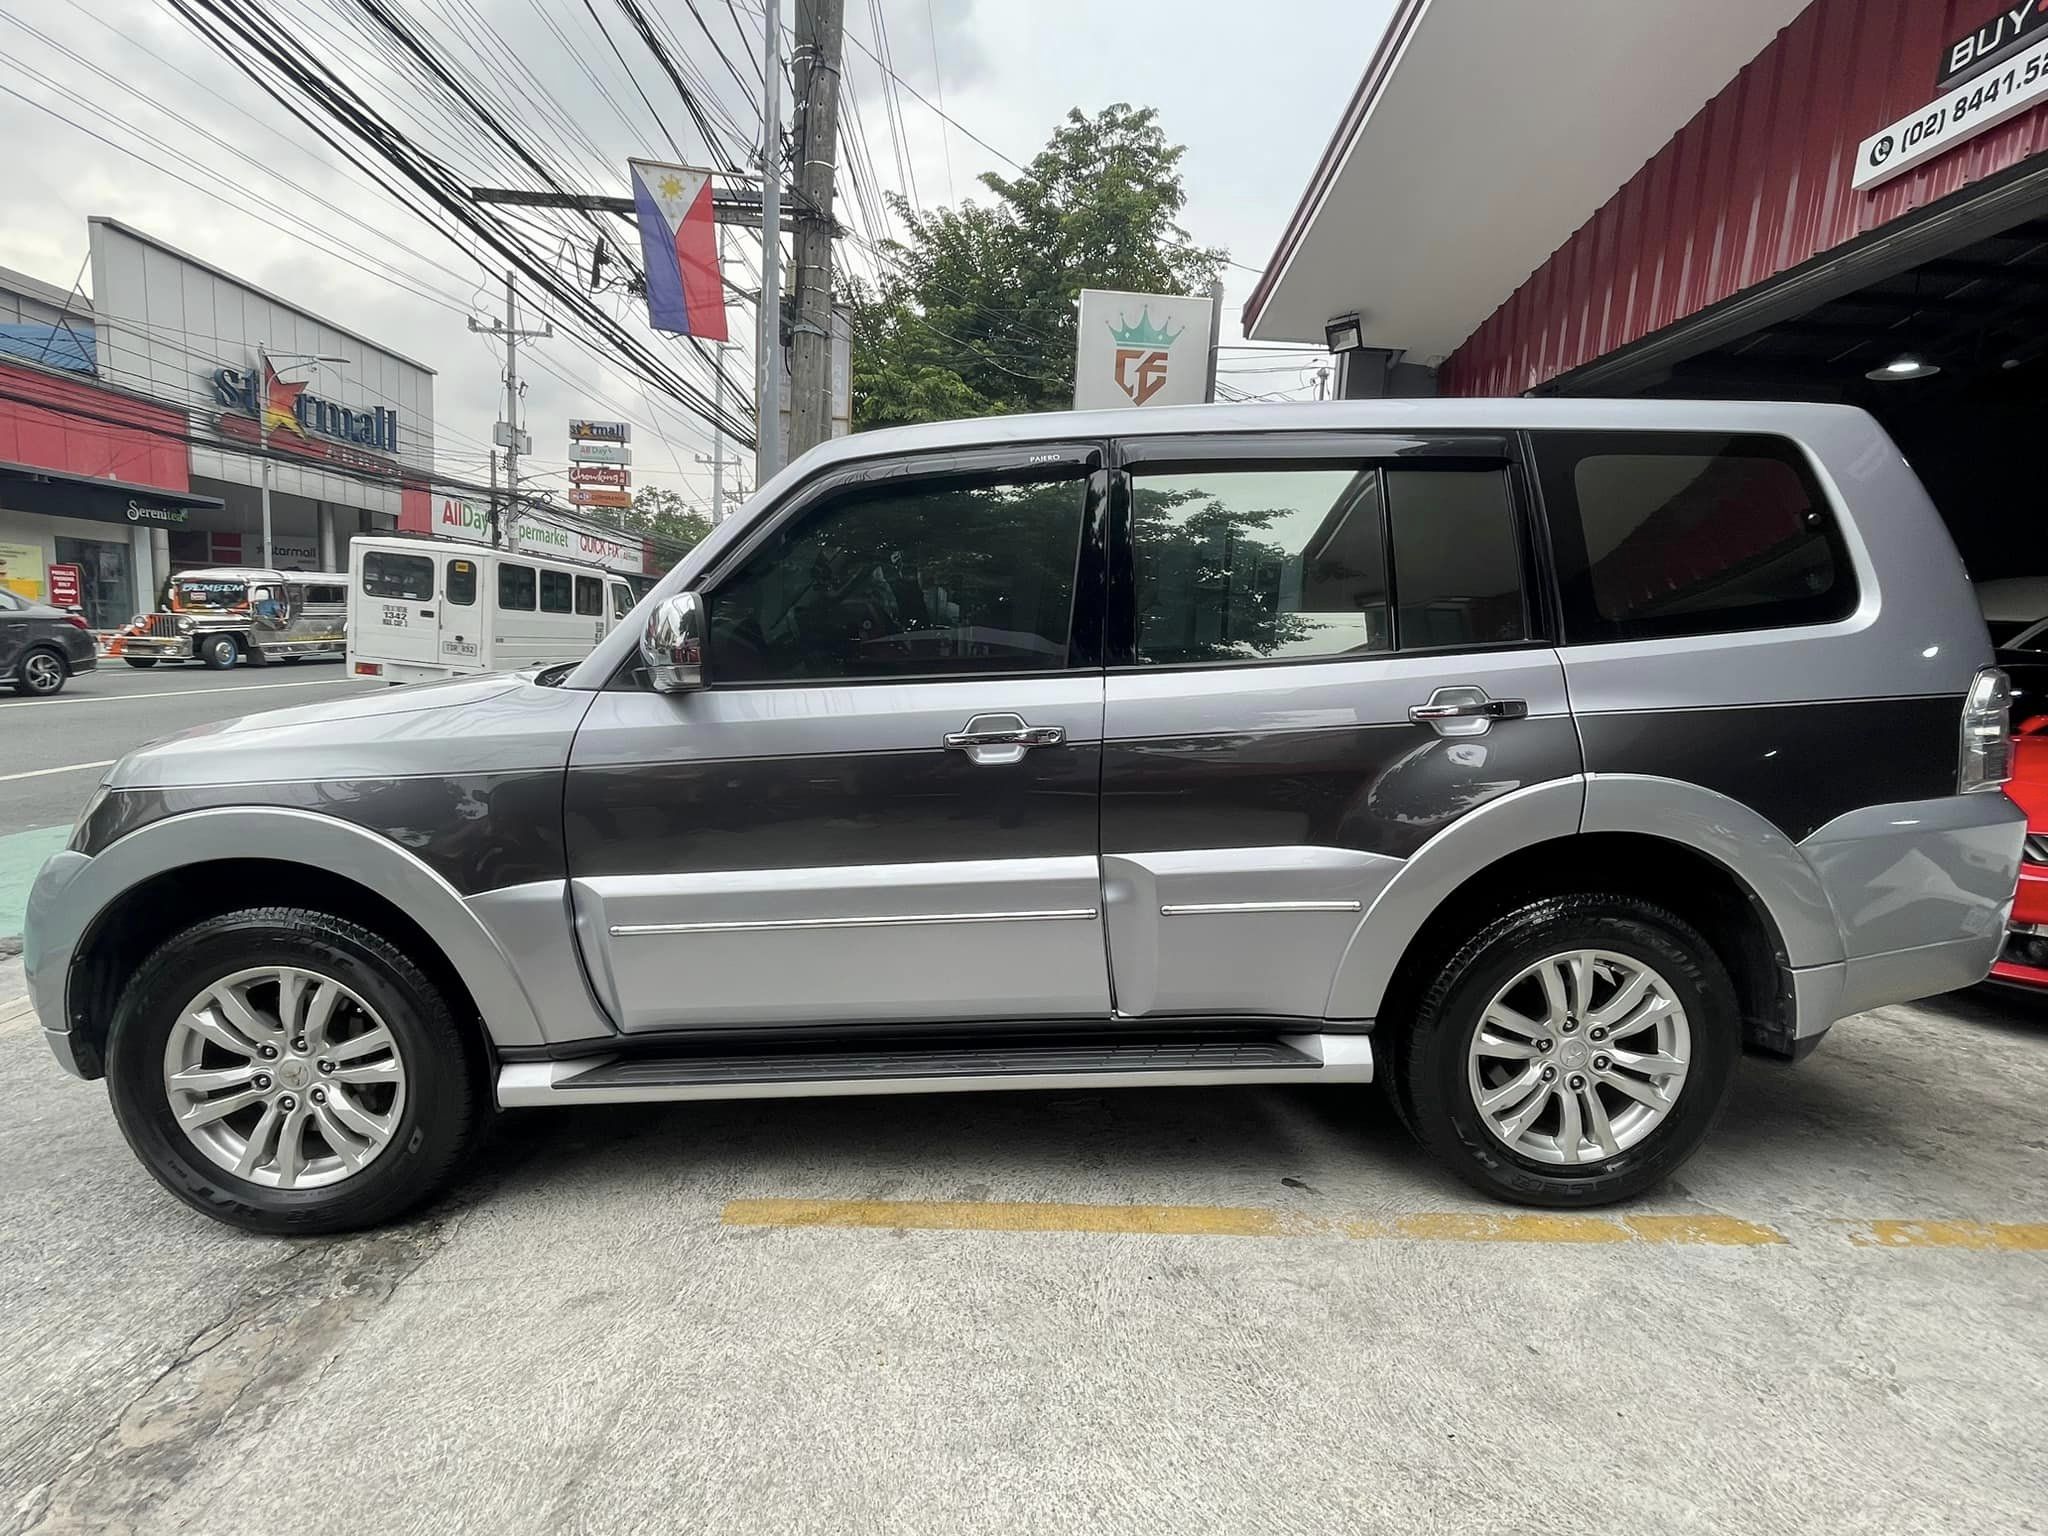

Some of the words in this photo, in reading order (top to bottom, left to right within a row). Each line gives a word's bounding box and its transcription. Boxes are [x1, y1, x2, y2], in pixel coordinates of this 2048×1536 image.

[1949, 0, 2035, 73] BUY
[1901, 108, 1947, 154] (02)
[214, 356, 399, 454] strmall
[127, 500, 184, 522] Serenitea
[271, 546, 316, 558] tarmall
[517, 523, 569, 548] permarket
